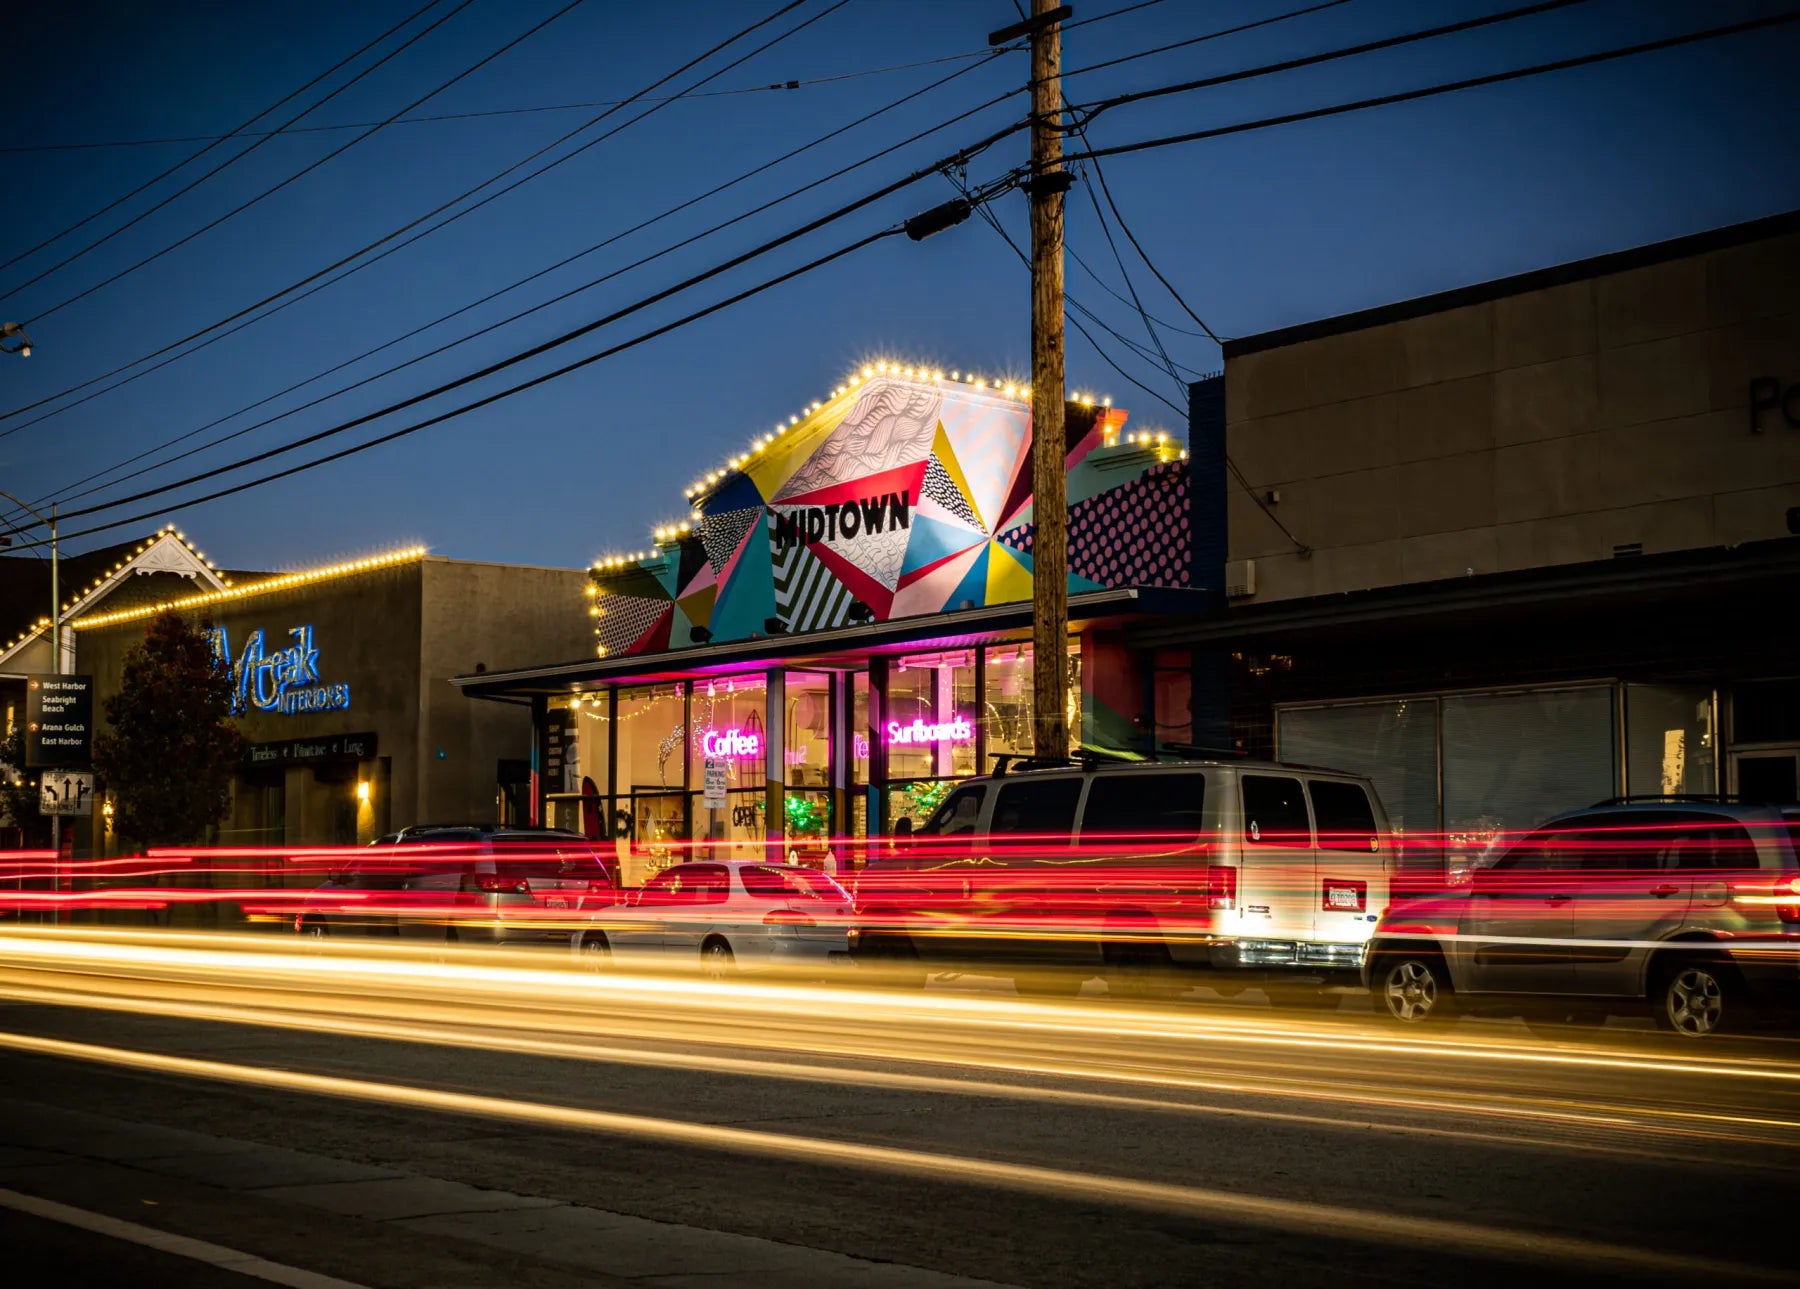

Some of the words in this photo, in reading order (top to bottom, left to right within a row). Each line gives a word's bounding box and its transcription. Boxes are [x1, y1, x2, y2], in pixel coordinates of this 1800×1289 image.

[776, 490, 909, 549] MIDTOWN
[43, 682, 61, 690] West
[62, 682, 86, 690] Harbor
[42, 696, 76, 706] Seabright
[278, 684, 348, 713] INTERIORS
[42, 737, 57, 745] East
[58, 737, 83, 745] Harbor
[888, 716, 971, 744] Surfboards
[703, 729, 759, 757] Coffee
[706, 759, 714, 768] 2
[733, 804, 757, 827] OPEN
